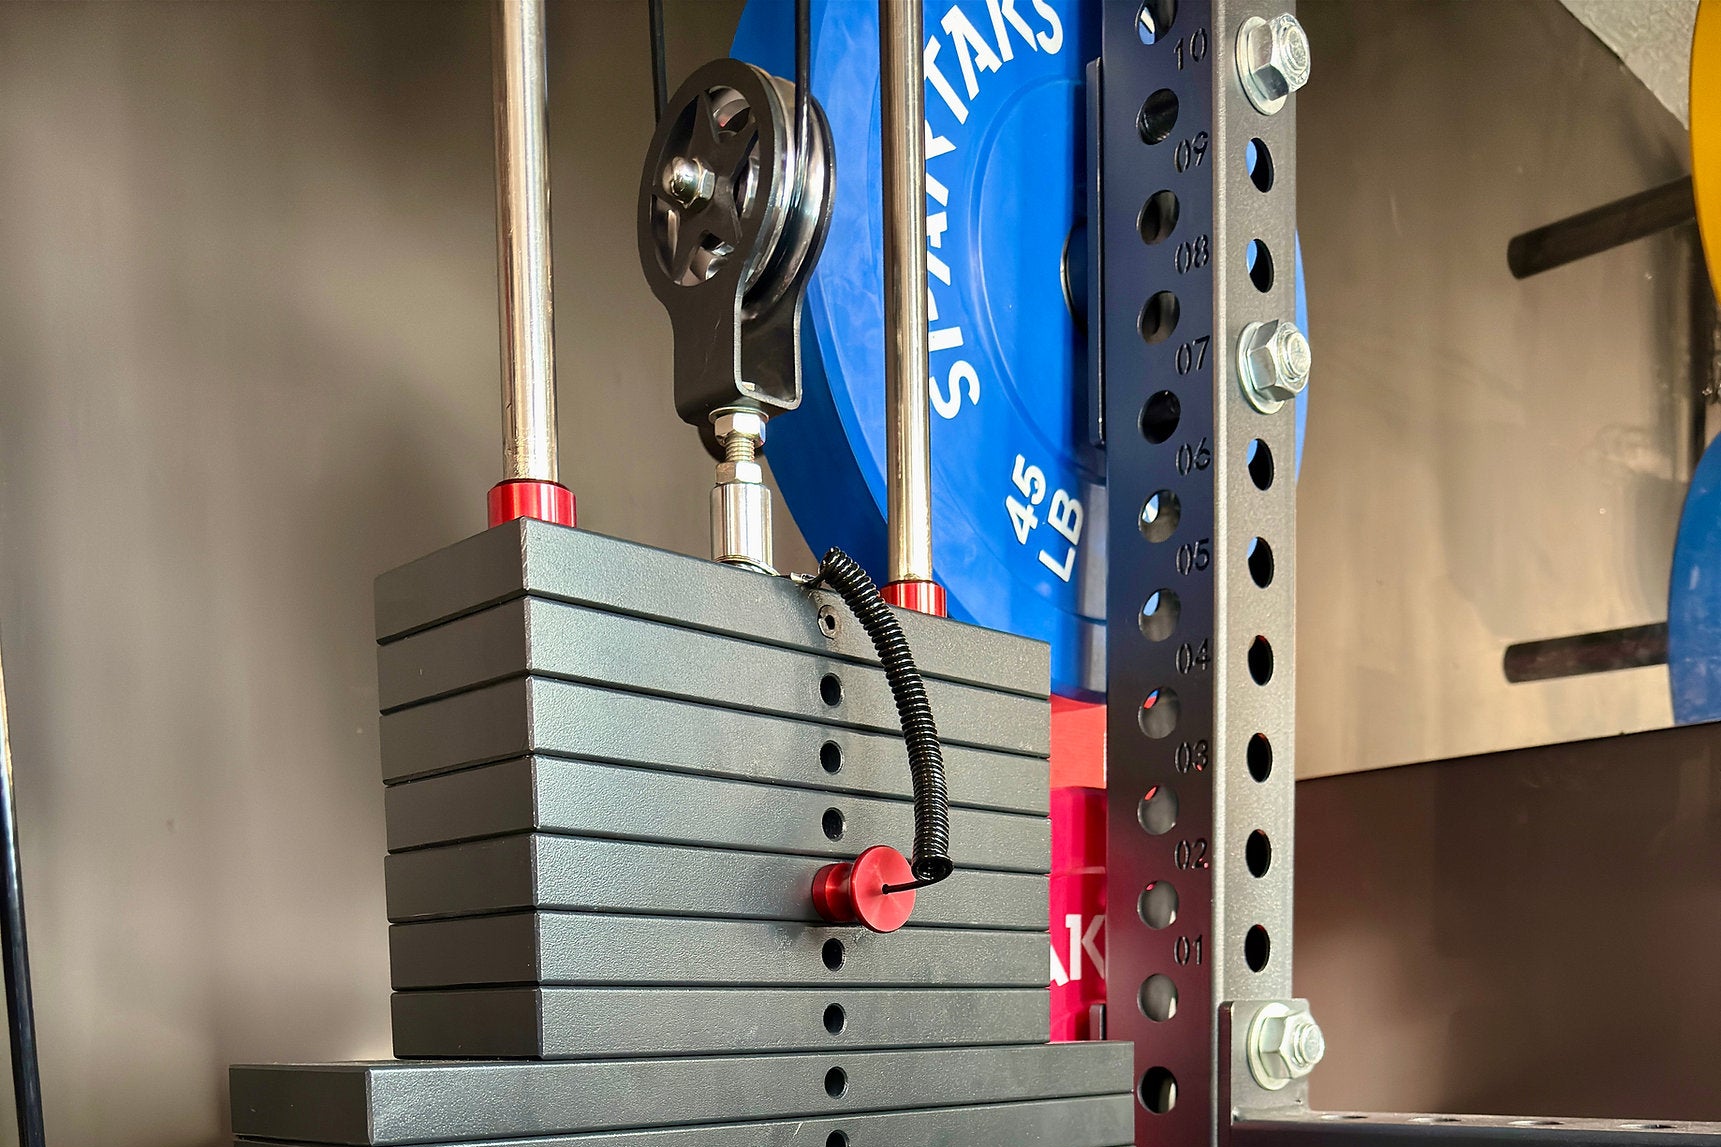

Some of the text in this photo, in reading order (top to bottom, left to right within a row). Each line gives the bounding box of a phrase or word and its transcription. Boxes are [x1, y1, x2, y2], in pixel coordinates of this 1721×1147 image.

[1174, 28, 1208, 71] 10
[1174, 131, 1209, 173] 09
[1174, 234, 1209, 275] 08
[1175, 335, 1211, 375] 07
[1175, 437, 1211, 476] 06
[1005, 453, 1046, 545] 45
[1038, 488, 1084, 583] LB
[1176, 538, 1210, 576] 05
[1176, 638, 1211, 675] 04
[1174, 739, 1208, 774] 03
[1174, 838, 1209, 871] 02
[1174, 934, 1203, 966] 01
